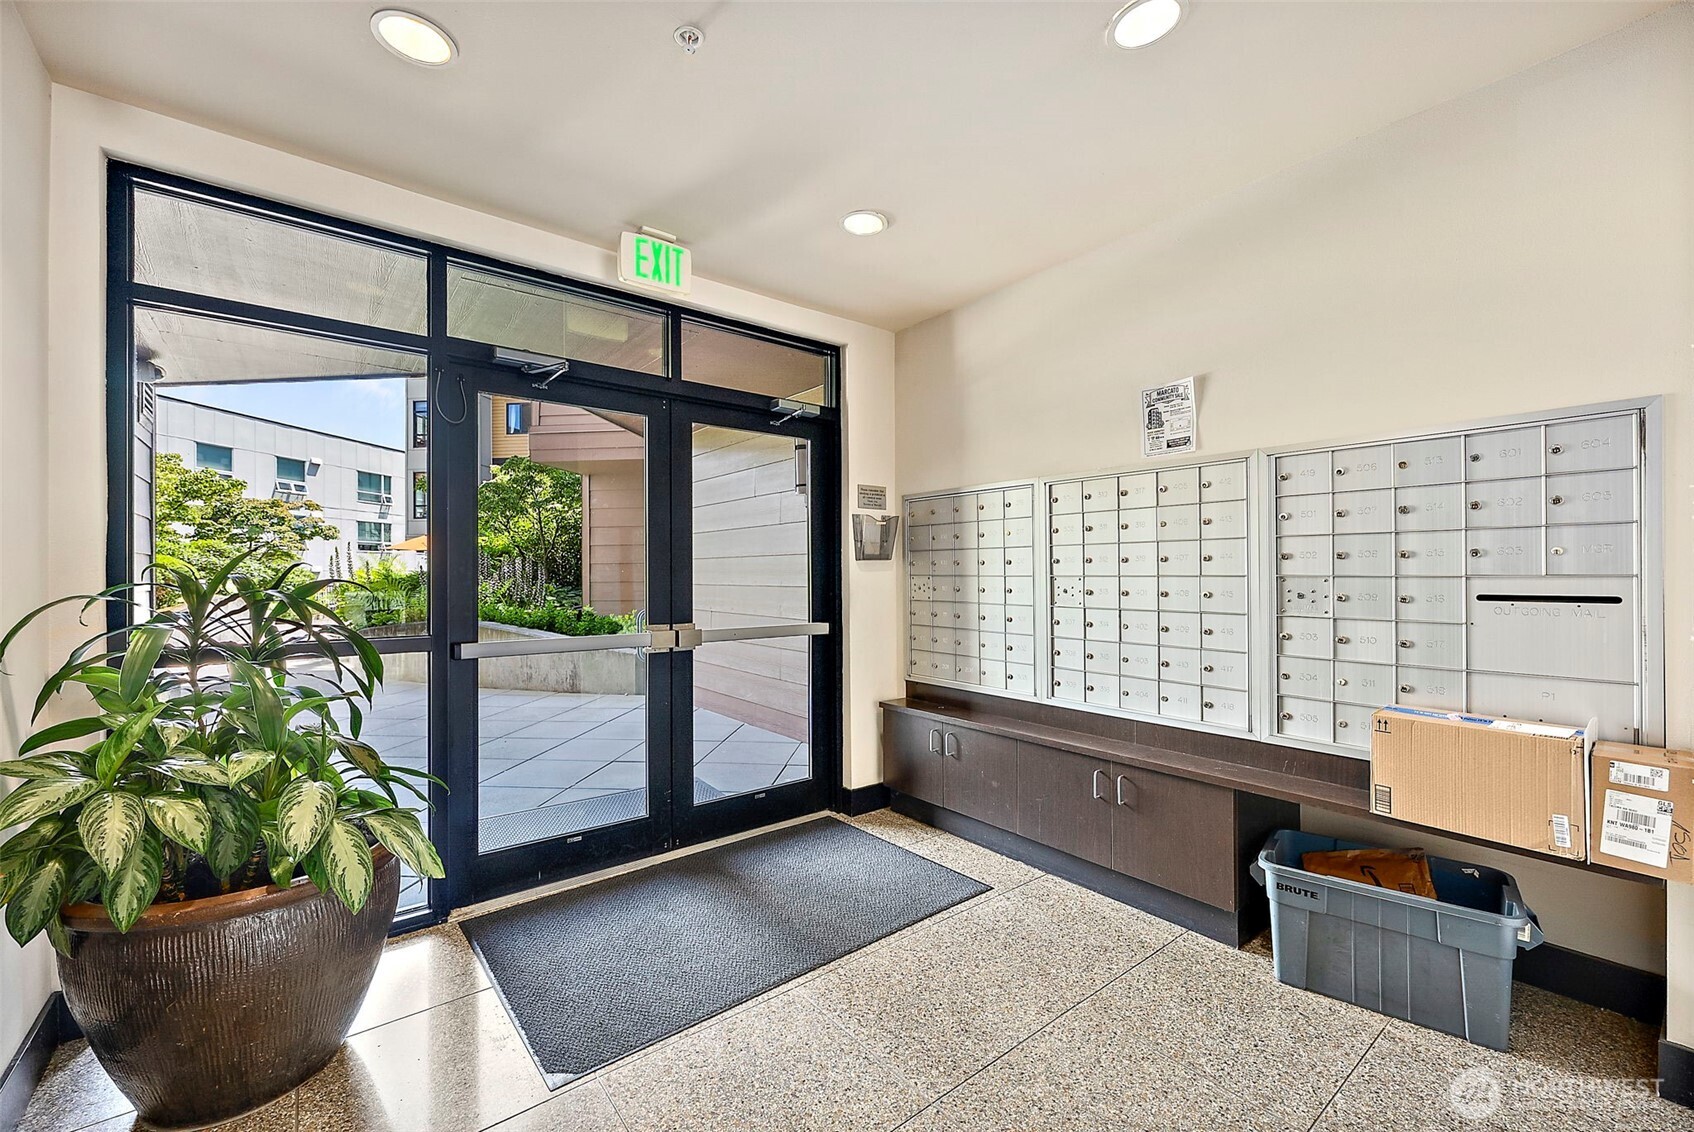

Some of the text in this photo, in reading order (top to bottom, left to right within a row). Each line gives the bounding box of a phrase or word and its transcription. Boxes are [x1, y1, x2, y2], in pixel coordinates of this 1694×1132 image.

[635, 236, 684, 287] EXIT
[1156, 386, 1180, 397] MARCATO
[1581, 437, 1611, 449] 604
[1499, 447, 1522, 458] 601
[1356, 462, 1378, 473] 506
[1300, 468, 1316, 478] 419
[1497, 496, 1523, 507] 602
[1582, 491, 1613, 502] 605
[1300, 510, 1317, 518] 501
[1299, 551, 1318, 560] 502
[1497, 545, 1524, 556] 603
[1357, 592, 1379, 602] 509
[1493, 606, 1607, 619] OUTGOING MAIL
[1299, 632, 1319, 641] 503
[1359, 635, 1378, 645] 510
[1299, 672, 1318, 682] 504
[1361, 679, 1376, 687] 511
[1541, 691, 1555, 701] P1
[1299, 714, 1319, 723] 505
[1657, 800, 1672, 808] GLS
[1275, 881, 1320, 901] BRUTE
